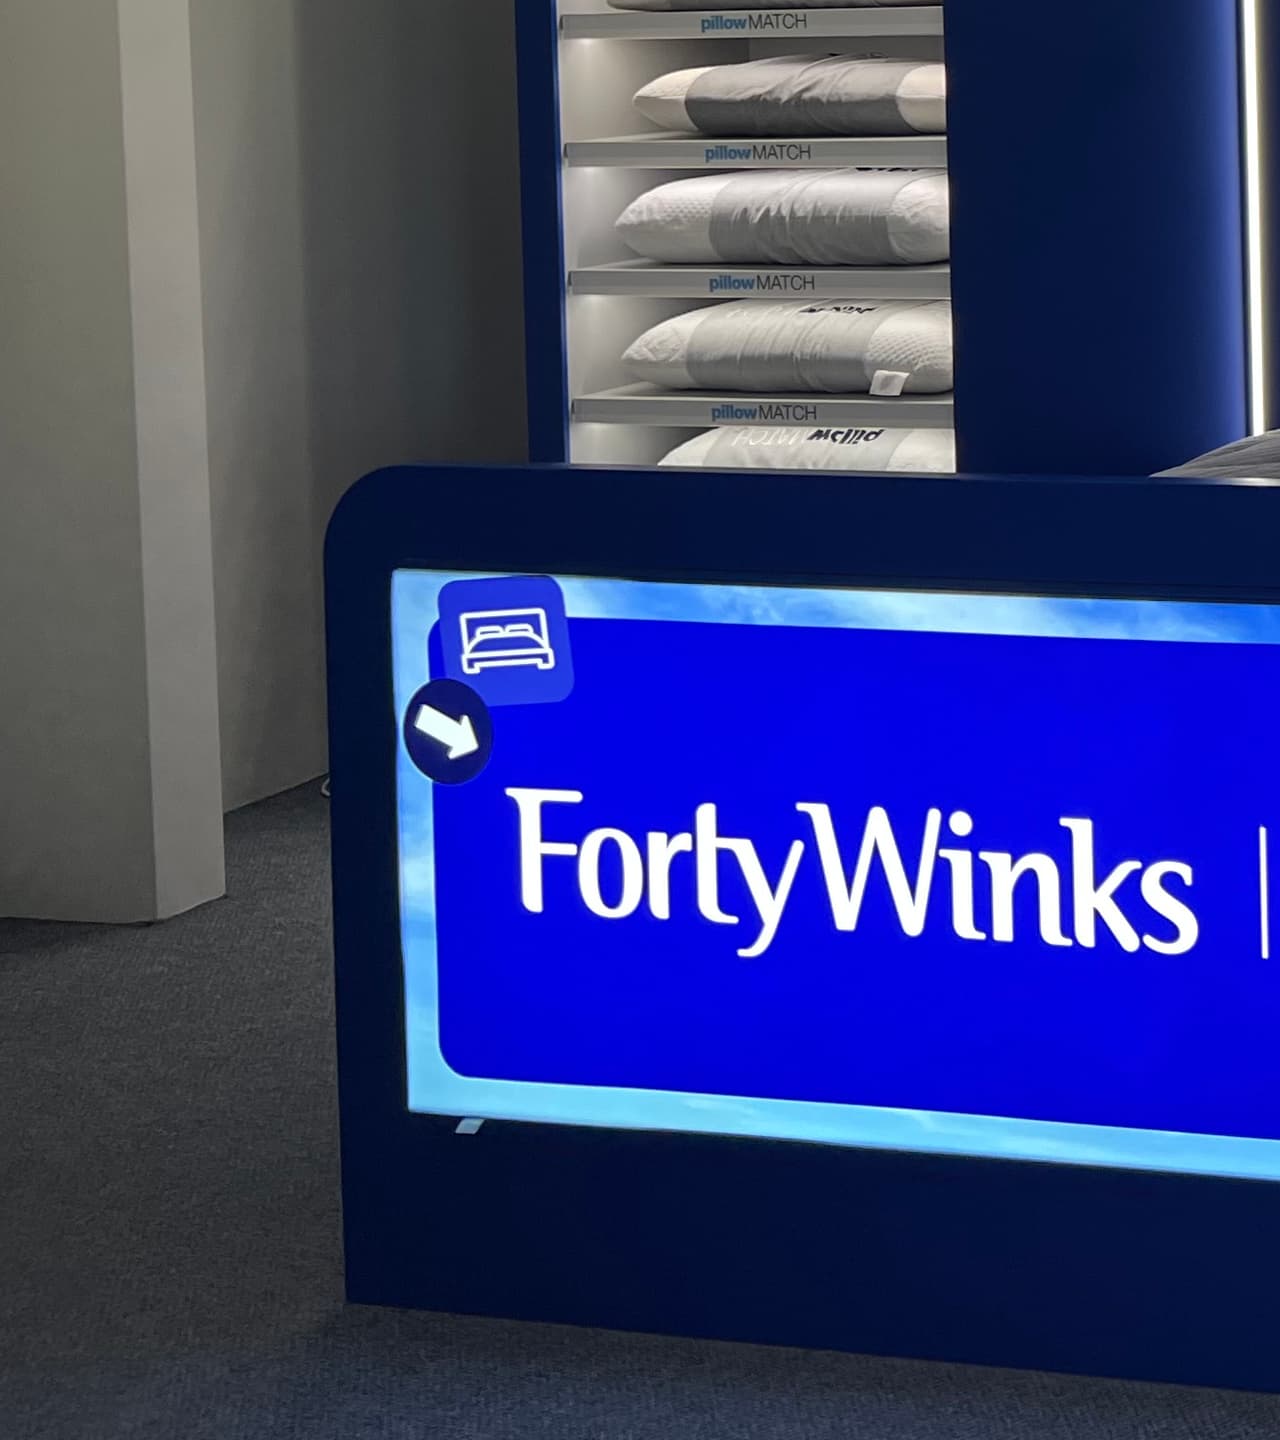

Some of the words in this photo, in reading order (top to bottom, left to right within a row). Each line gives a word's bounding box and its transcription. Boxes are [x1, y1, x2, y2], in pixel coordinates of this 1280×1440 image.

[700, 13, 808, 33] pillowMATCH
[704, 144, 812, 164] pillowMATCH
[708, 275, 816, 294] pillowMATCH
[711, 404, 818, 424] pillowMATCH
[505, 786, 1200, 958] FortyWinks
